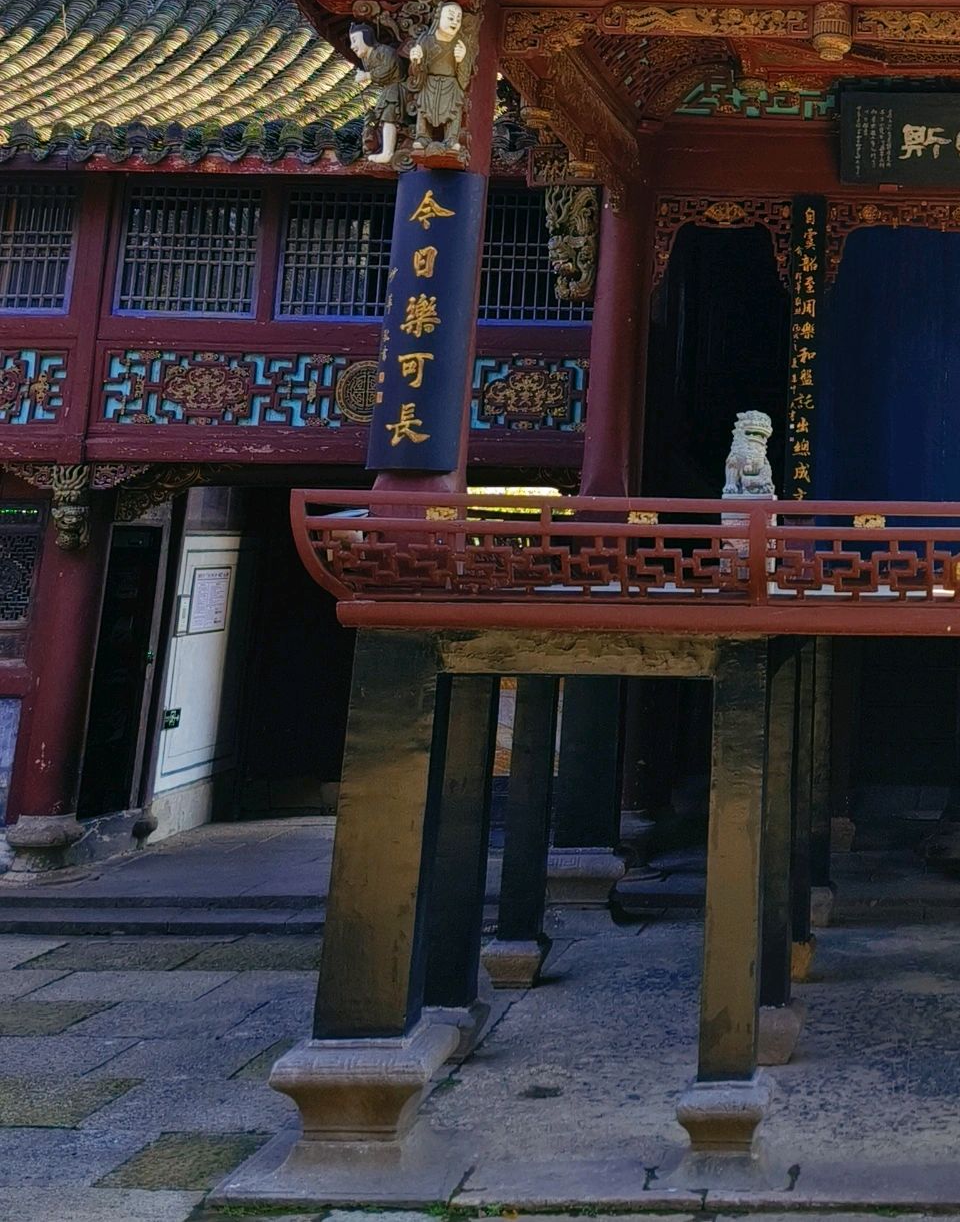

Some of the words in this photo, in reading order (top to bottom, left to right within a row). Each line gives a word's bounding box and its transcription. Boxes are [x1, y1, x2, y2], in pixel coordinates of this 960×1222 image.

[385, 190, 456, 447] 今日樂可長
